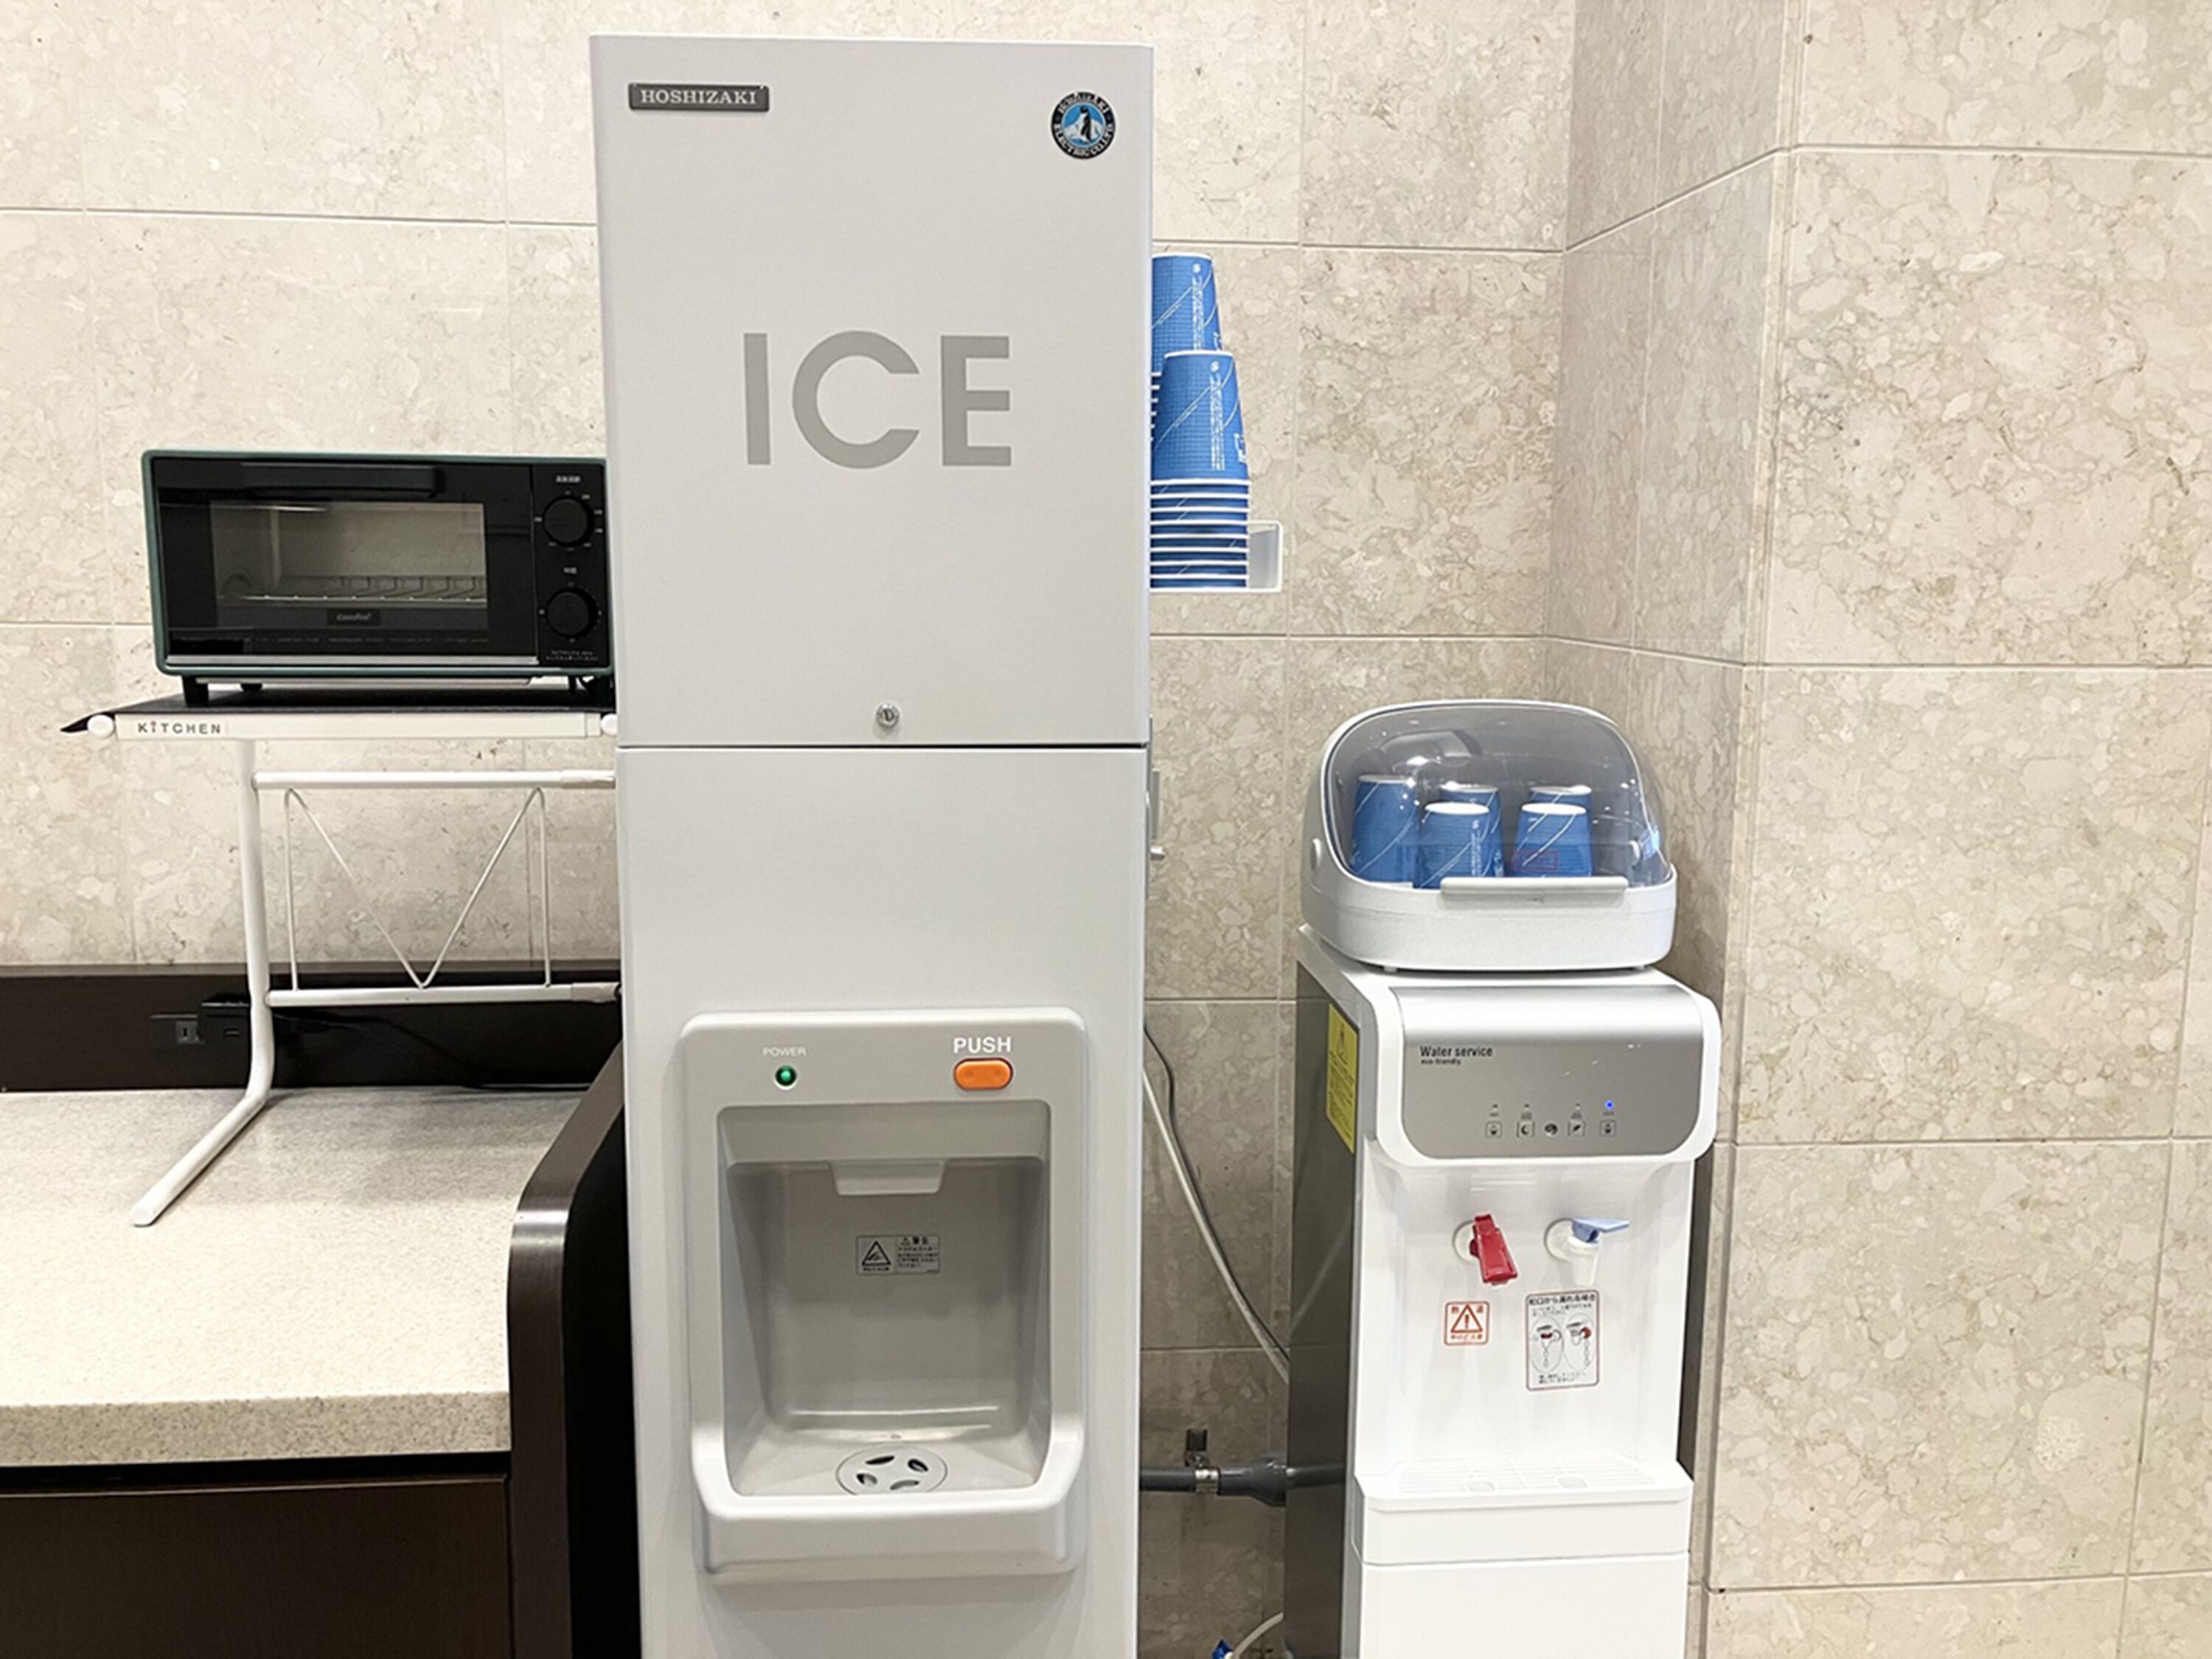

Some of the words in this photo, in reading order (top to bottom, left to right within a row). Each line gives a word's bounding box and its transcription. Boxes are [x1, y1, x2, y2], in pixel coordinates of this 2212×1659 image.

[641, 89, 757, 105] HOSHIZAKI
[743, 330, 1012, 469] ICE
[762, 1047, 806, 1057] POWER
[953, 1037, 1012, 1054] PUSH
